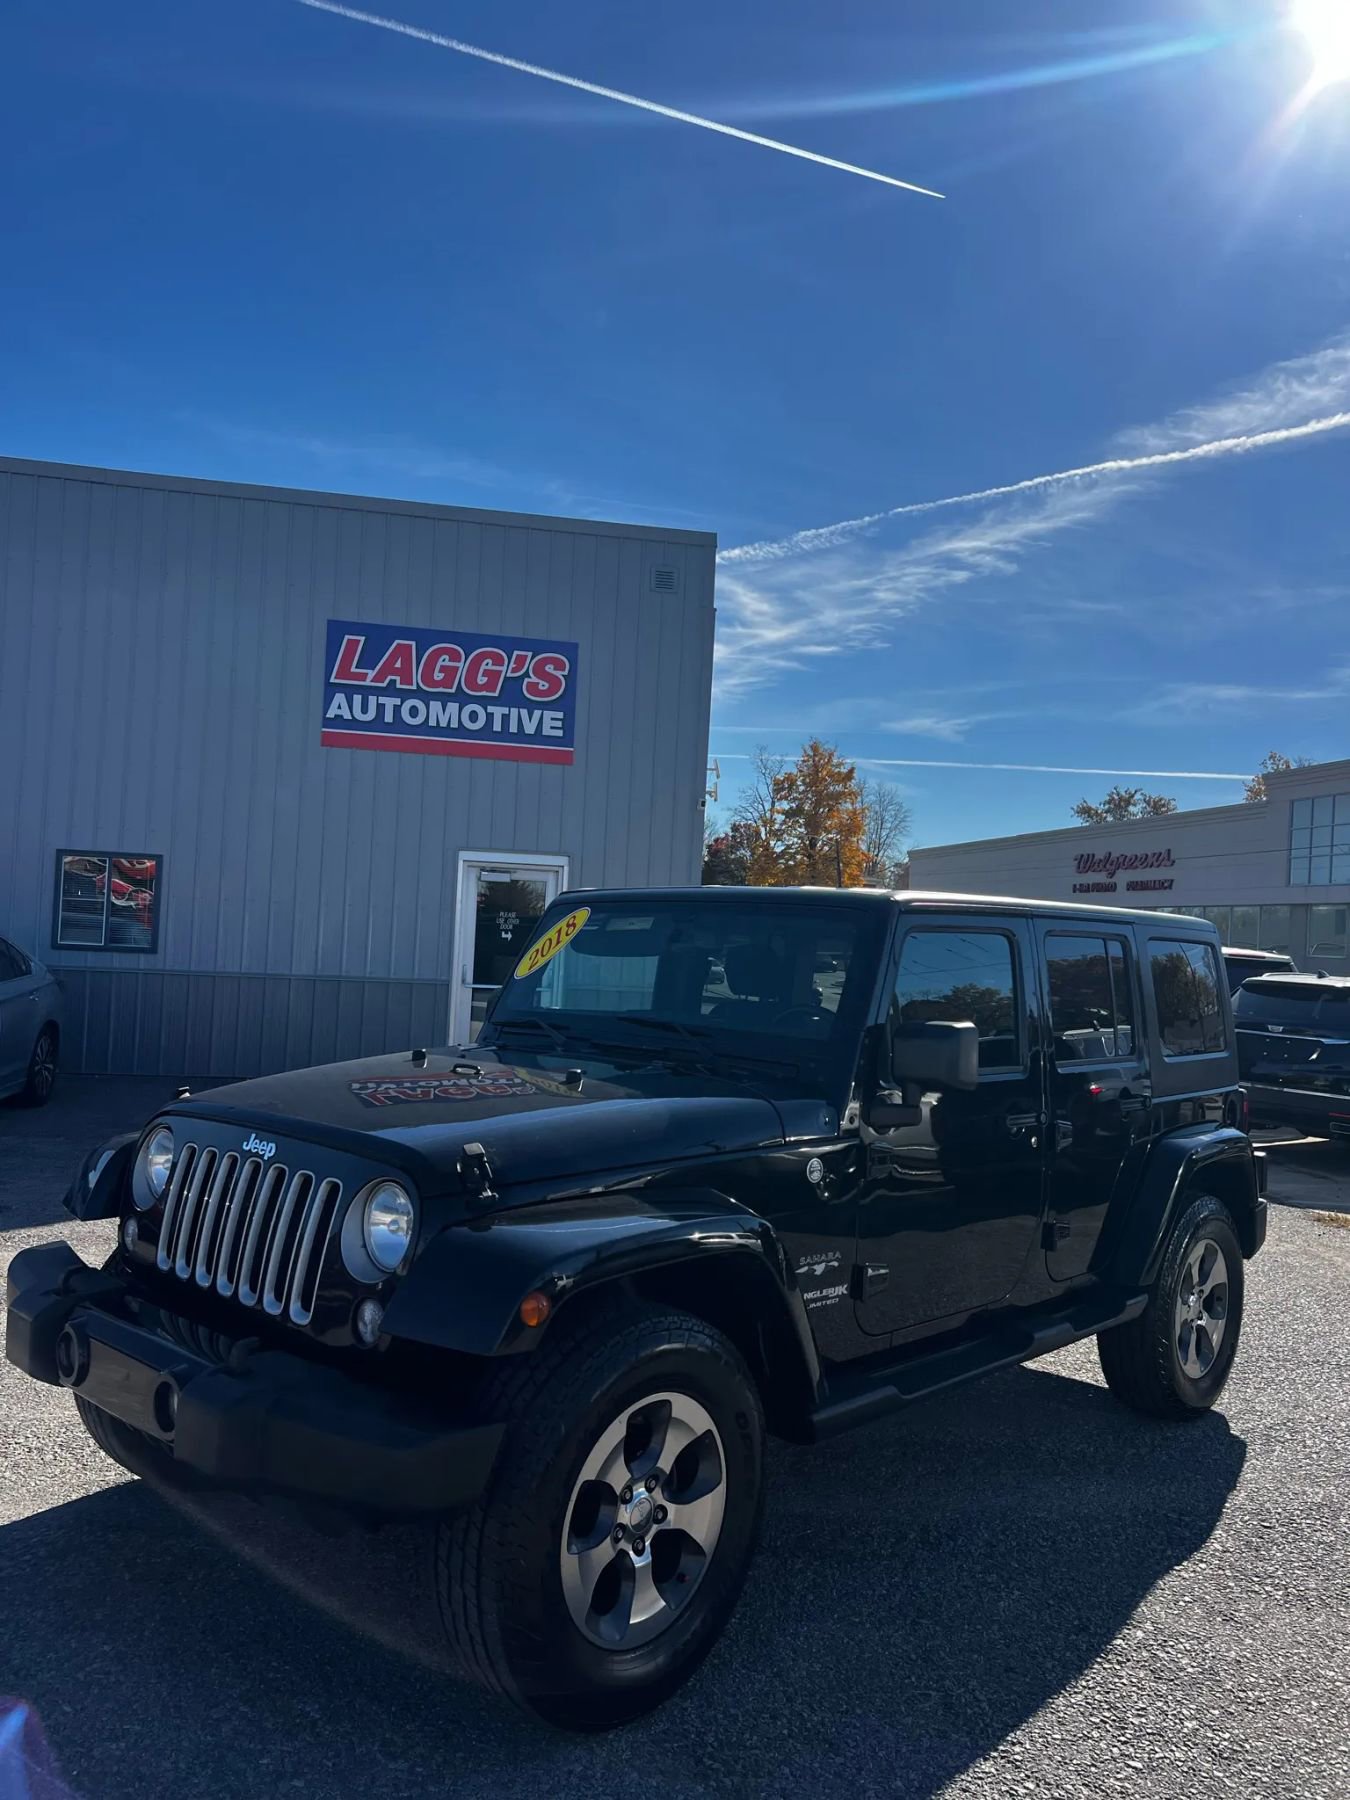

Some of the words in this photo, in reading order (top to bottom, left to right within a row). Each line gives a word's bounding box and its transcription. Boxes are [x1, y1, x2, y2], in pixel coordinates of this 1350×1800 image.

[329, 634, 570, 701] LAGG'S
[326, 692, 564, 737] AUTOMOTIVE
[1073, 848, 1176, 879] Walgreens
[528, 915, 577, 971] 2018
[242, 1133, 276, 1160] Jeep
[799, 1251, 841, 1265] SAHARA
